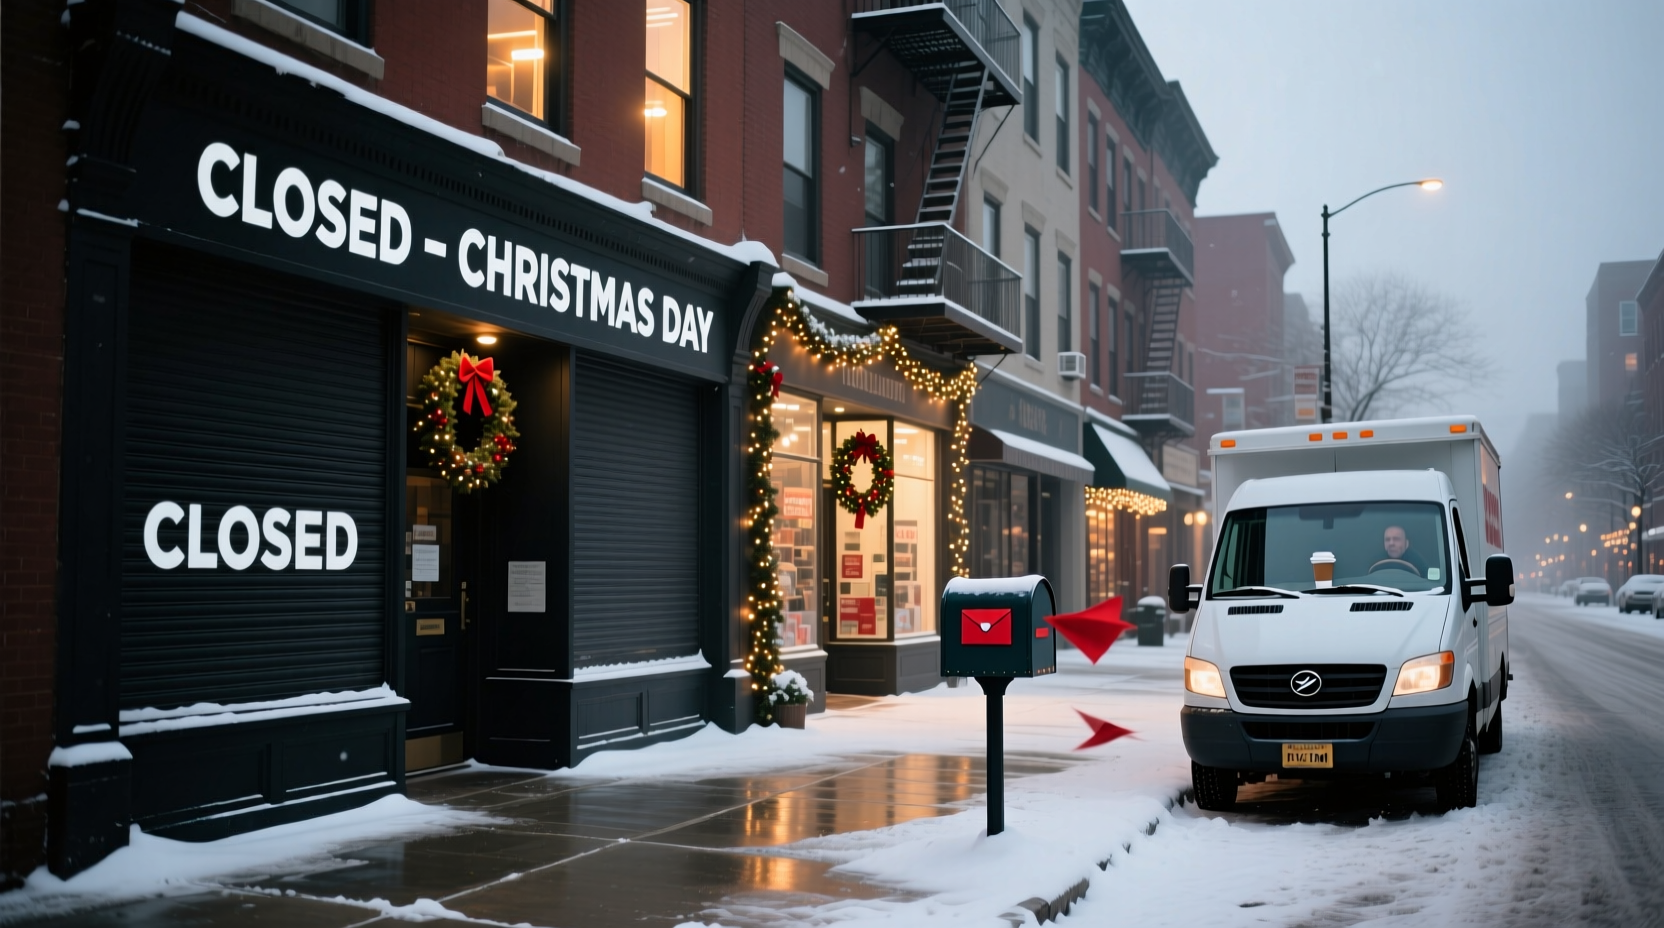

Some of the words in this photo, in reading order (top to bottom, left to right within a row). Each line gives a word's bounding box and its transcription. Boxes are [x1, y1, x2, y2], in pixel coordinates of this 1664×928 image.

[198, 142, 412, 265] CLOSED
[458, 228, 655, 338] CHRISTMAS
[662, 295, 715, 354] DAY
[143, 500, 359, 571] CLOSED
